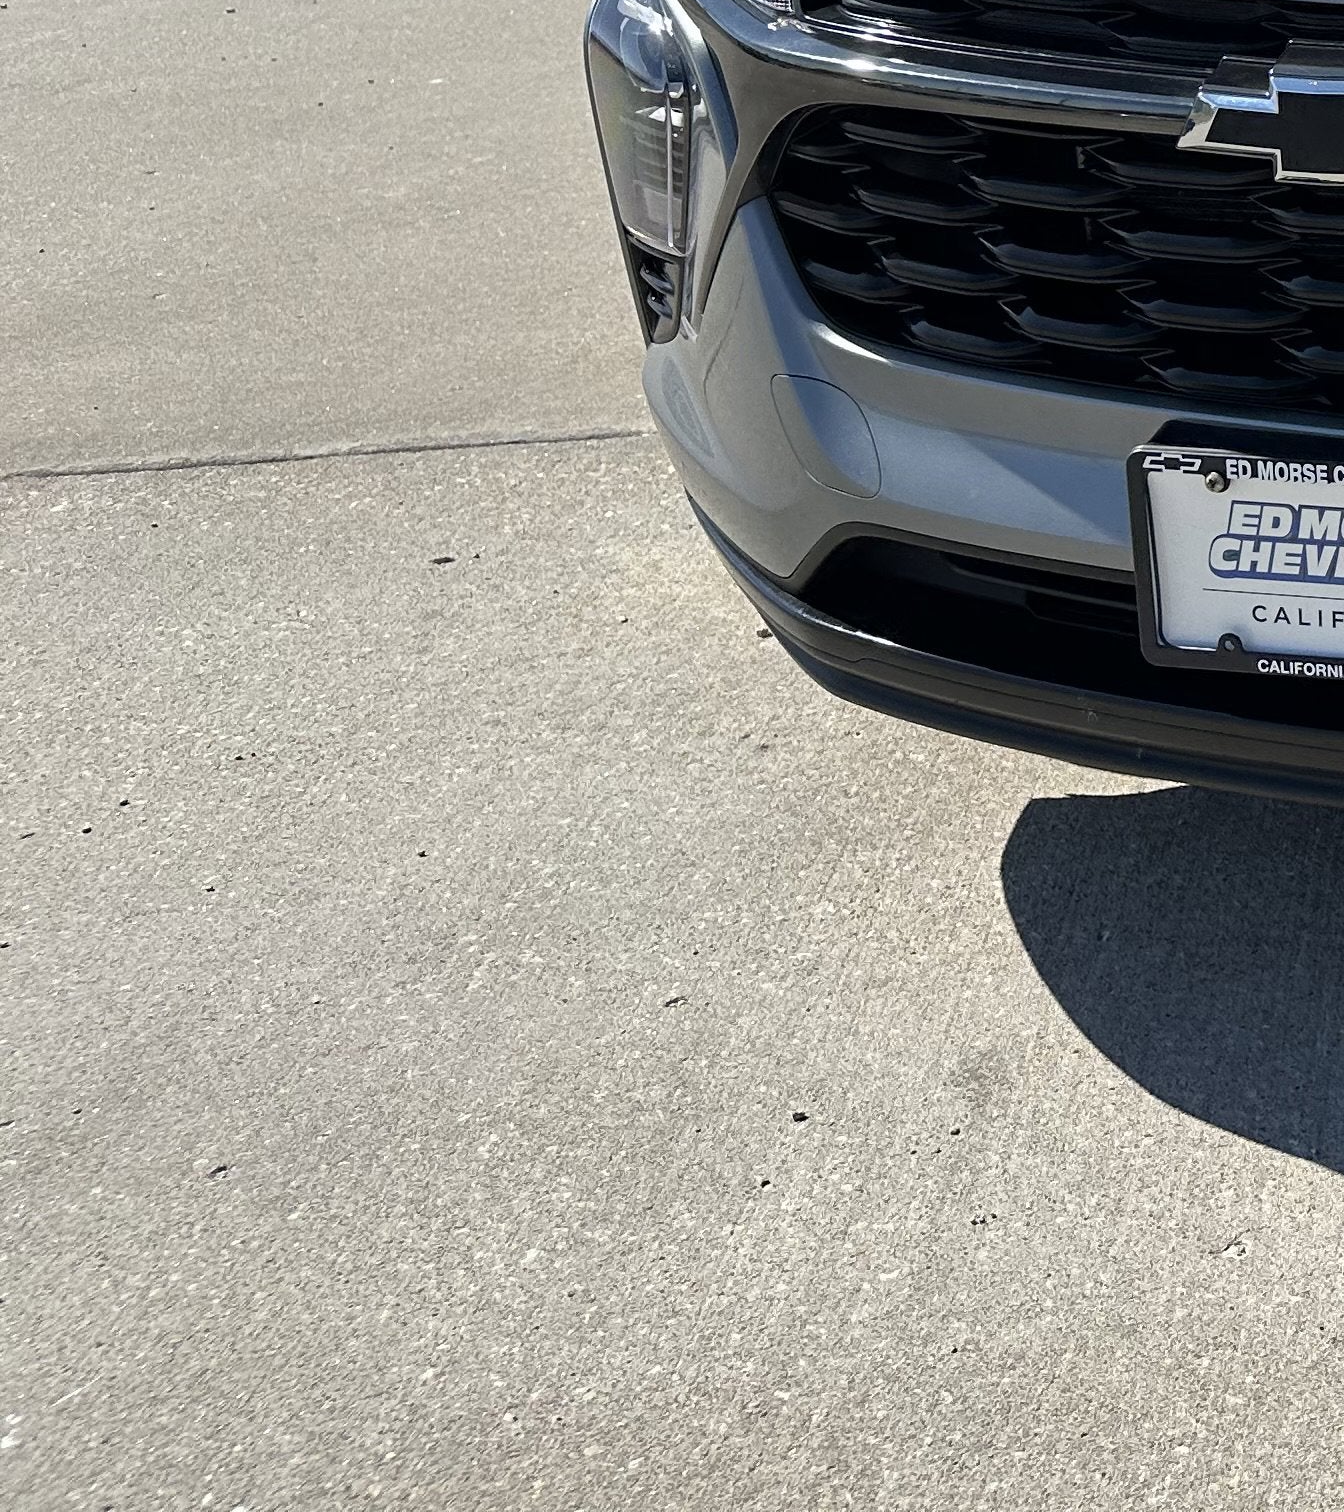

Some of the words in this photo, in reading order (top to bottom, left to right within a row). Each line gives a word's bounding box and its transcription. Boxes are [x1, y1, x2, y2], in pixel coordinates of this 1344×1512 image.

[1225, 459, 1251, 480] ED
[1257, 460, 1328, 485] MORSE
[1227, 501, 1295, 538] ED
